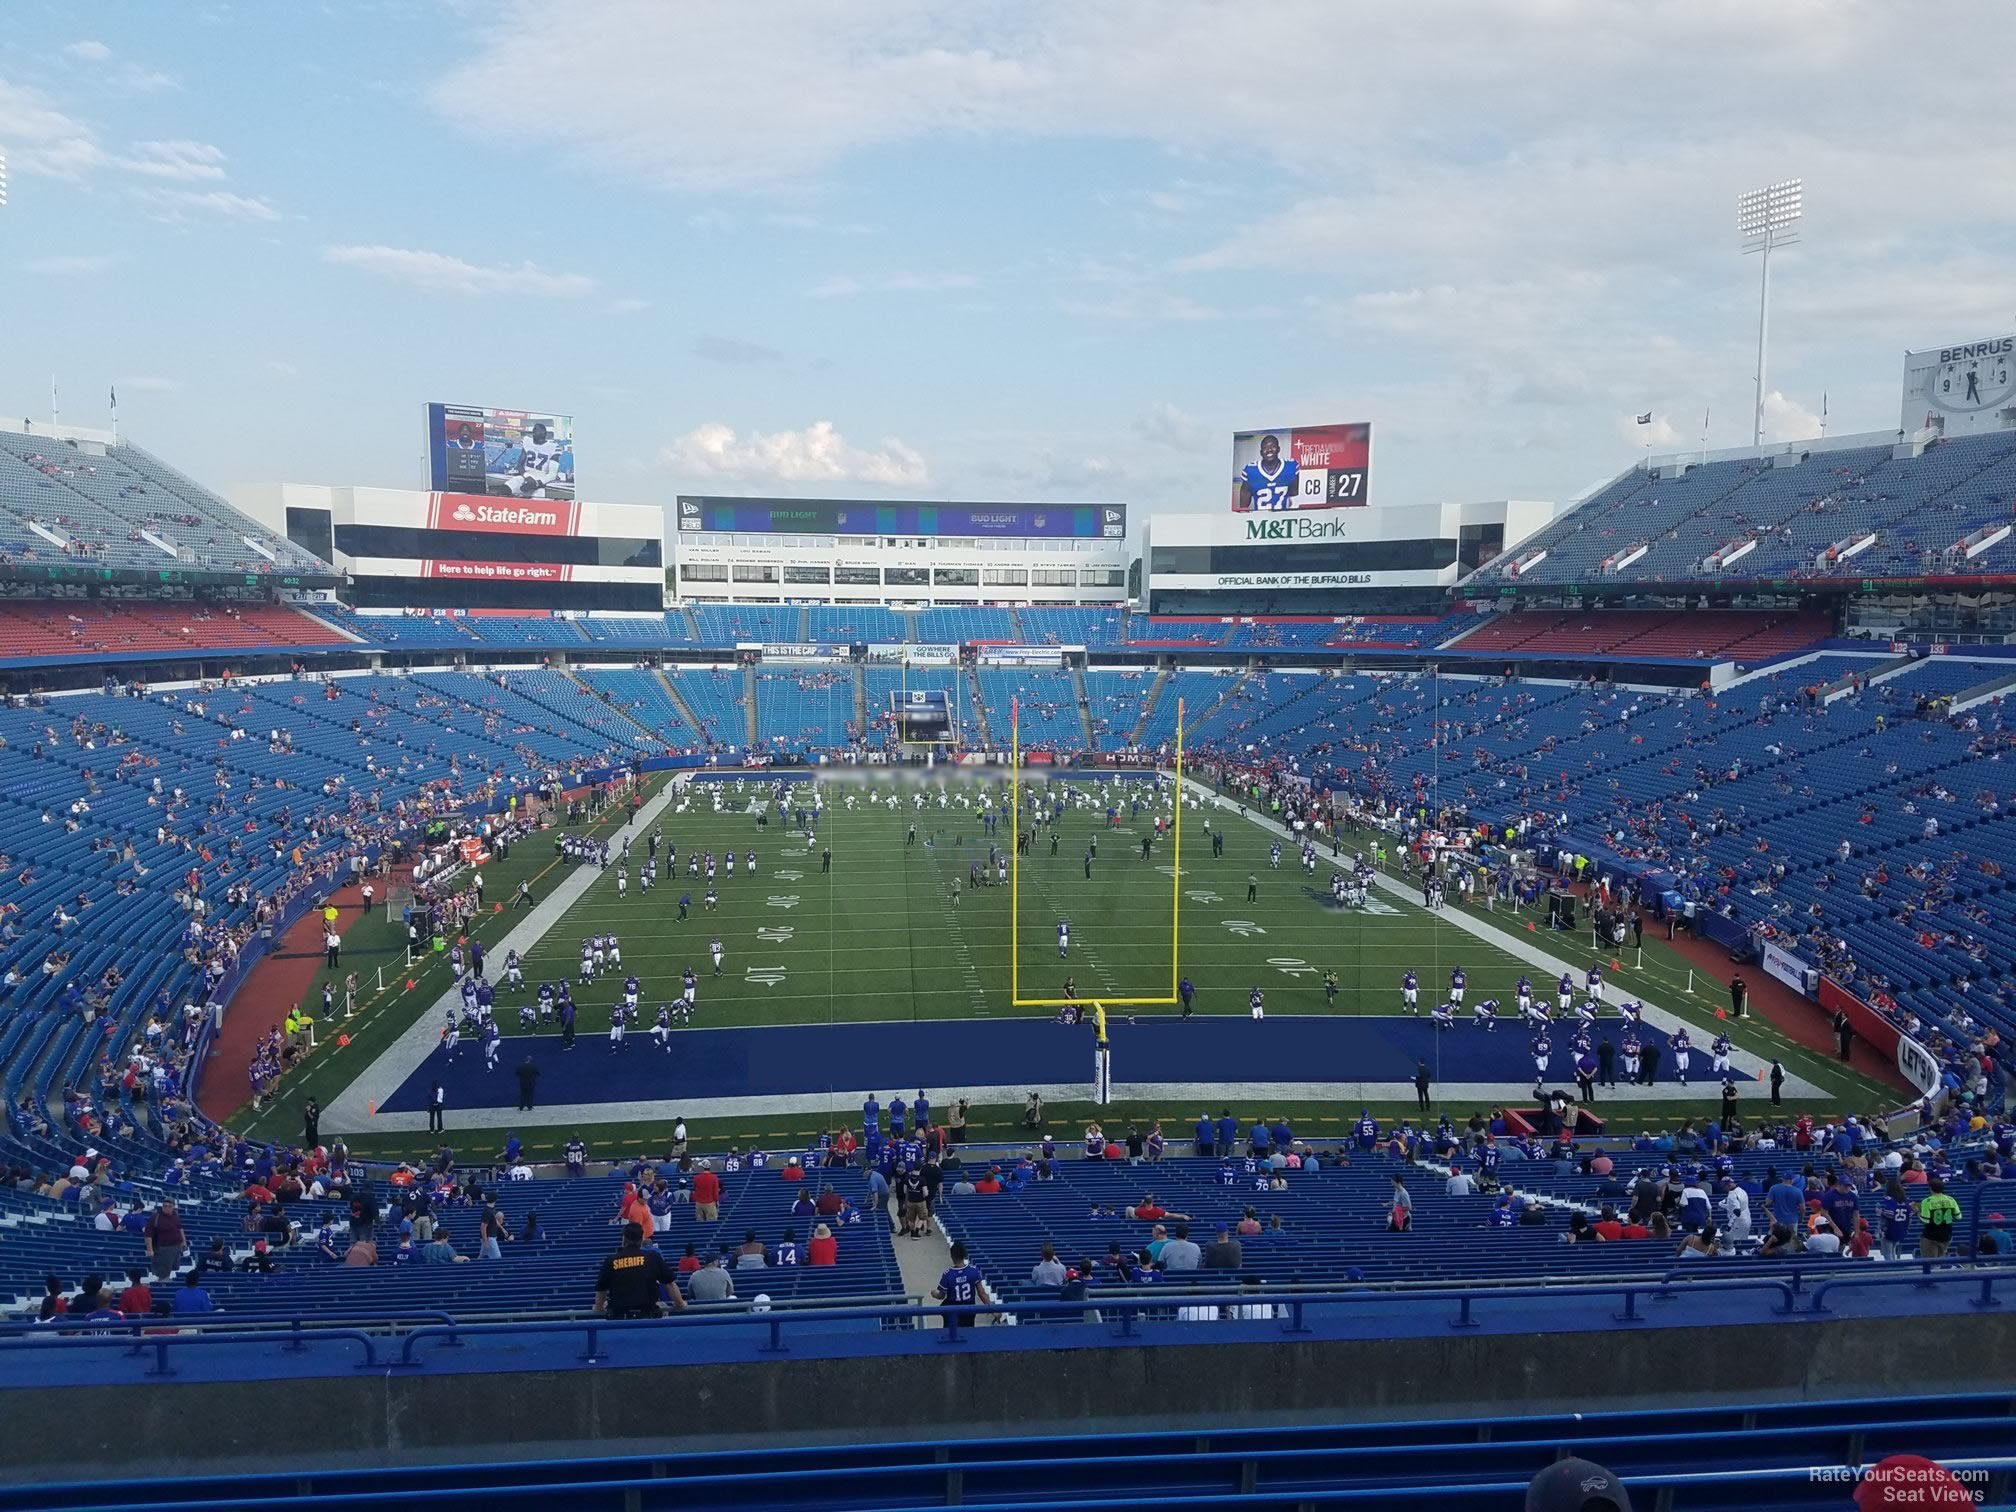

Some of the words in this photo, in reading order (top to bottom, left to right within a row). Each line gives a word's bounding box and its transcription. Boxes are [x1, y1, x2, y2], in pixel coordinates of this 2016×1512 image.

[1940, 339, 2013, 363] BENRUS
[1999, 370, 2007, 385] 3
[525, 450, 549, 471] 27
[1301, 453, 1330, 467] WHITE
[1305, 479, 1321, 495] CB
[1338, 473, 1362, 497] 27
[1257, 486, 1288, 510] 27
[971, 514, 990, 522] BUD
[991, 515, 1016, 523] LIGHT
[1246, 519, 1298, 540] M&T
[1299, 516, 1346, 538] Bank
[439, 563, 462, 574] Here
[463, 566, 474, 574] to
[474, 565, 495, 576] help
[496, 566, 512, 576] life
[513, 568, 526, 578] go
[1218, 576, 1255, 586] OFFICIAL
[1256, 576, 1280, 584] BANK
[1280, 576, 1292, 584] OF
[1293, 575, 1310, 584] THE
[1311, 575, 1348, 584] BUFFALO
[1348, 574, 1372, 584] BILLS
[763, 645, 780, 655] THIS
[780, 645, 788, 655] IS
[788, 646, 802, 655] THE
[802, 646, 817, 655] CAP
[1893, 643, 1908, 653] 132
[1929, 644, 1944, 654] 133
[1106, 754, 1139, 762] HOME
[756, 926, 795, 940] 20
[1266, 957, 1319, 975] 10
[744, 966, 787, 982] 10
[1538, 1043, 1548, 1051] 69
[1902, 1043, 1927, 1080] LET'S
[1362, 1125, 1374, 1136] 55
[567, 1151, 583, 1163] 80
[752, 1158, 763, 1167] 88
[905, 1152, 916, 1162] 94
[1485, 1155, 1496, 1166] 14
[349, 1167, 364, 1177] 103
[726, 1161, 739, 1172] 69
[1224, 1177, 1234, 1185] 14
[1894, 1208, 1907, 1222] 25
[1933, 1209, 1952, 1226] 84
[613, 1256, 646, 1270] SHERIFF
[776, 1249, 797, 1266] 14
[954, 1283, 971, 1301] 12
